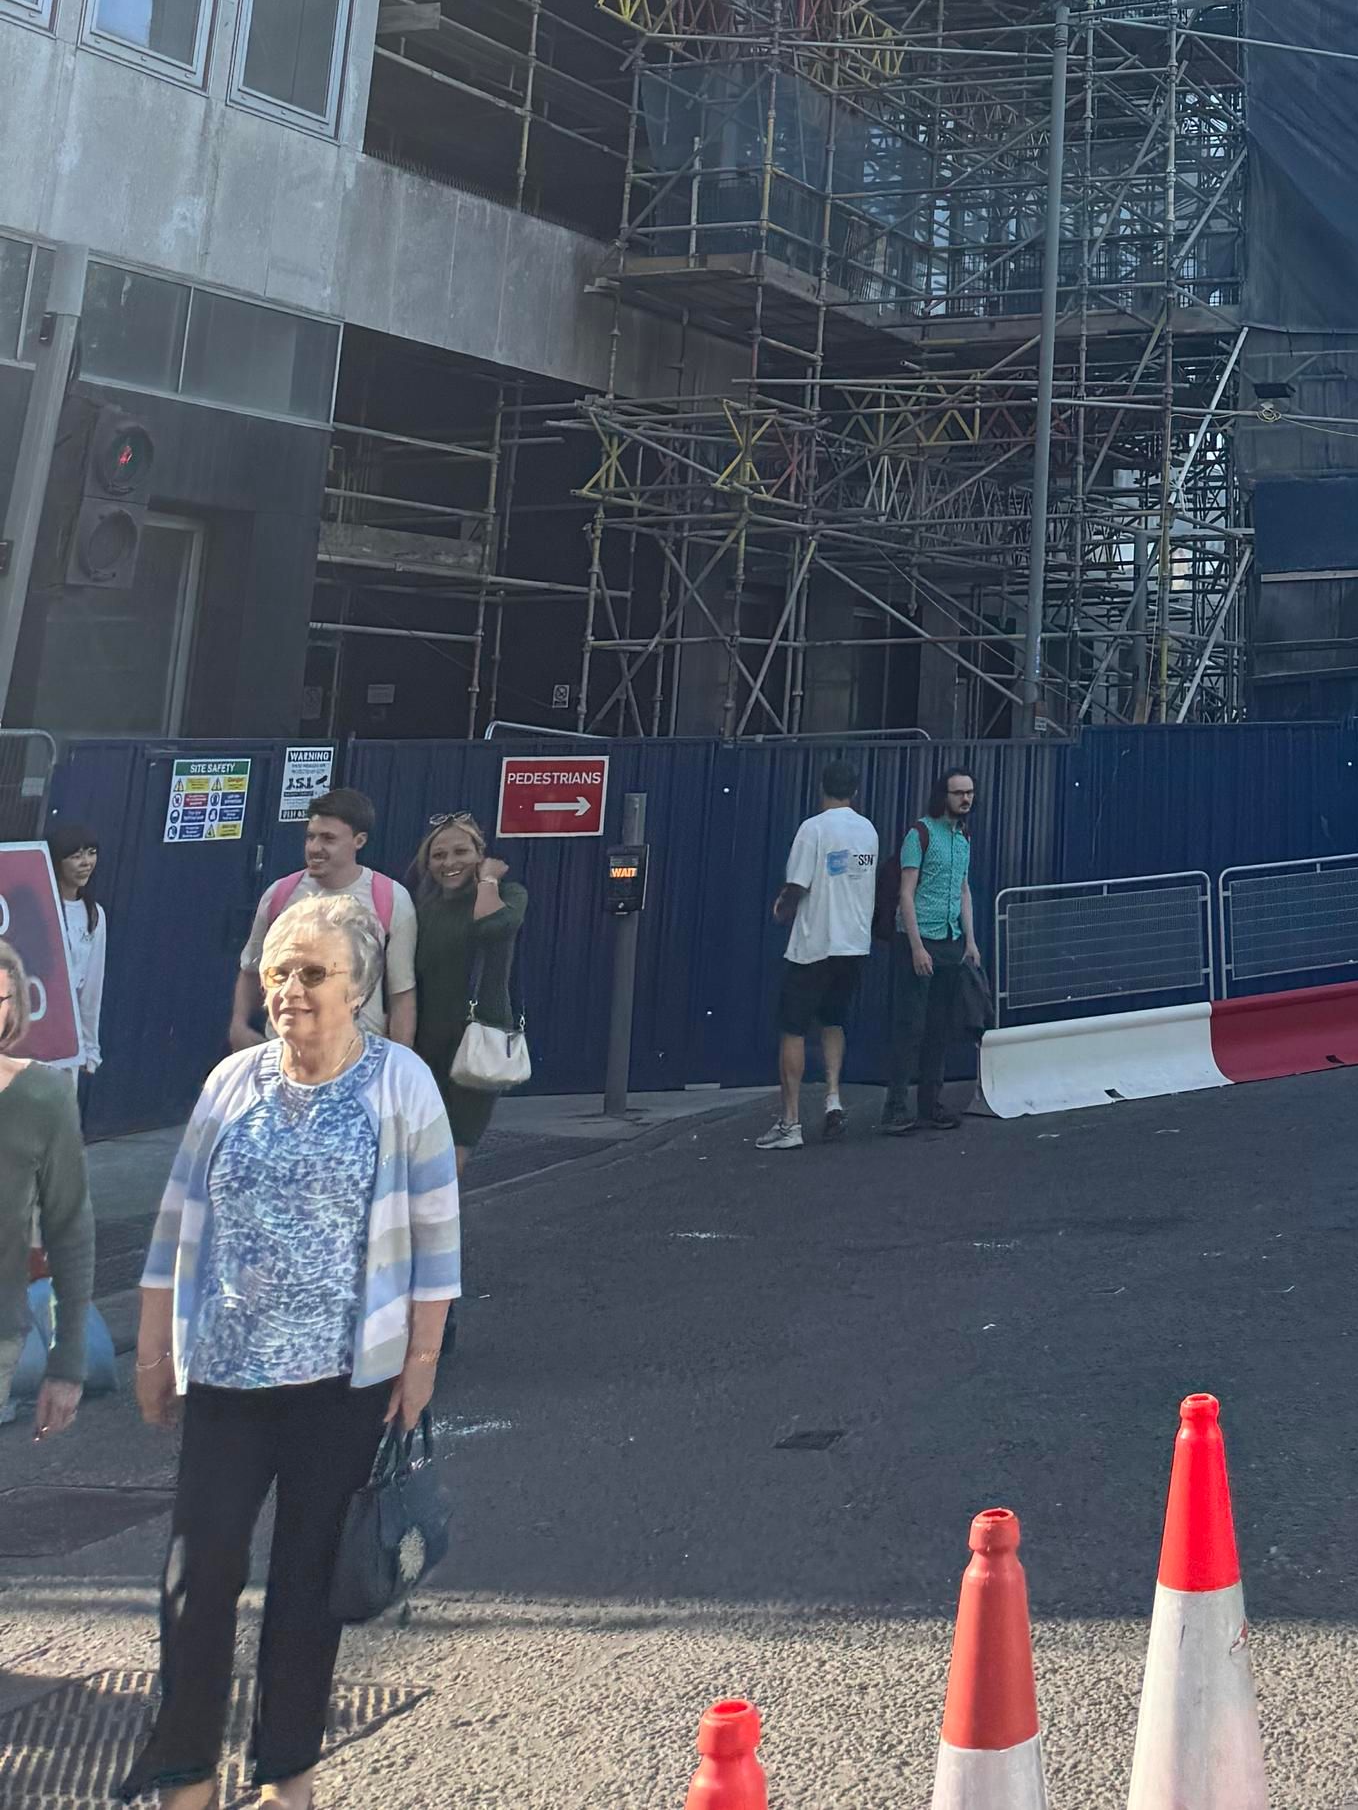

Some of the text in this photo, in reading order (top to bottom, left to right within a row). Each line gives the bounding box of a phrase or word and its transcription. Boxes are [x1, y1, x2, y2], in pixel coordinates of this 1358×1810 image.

[290, 751, 330, 761] WARNING
[190, 763, 235, 773] SITE SAFETY
[507, 772, 601, 784] PEDESTRIANS
[611, 868, 637, 877] WAIT
